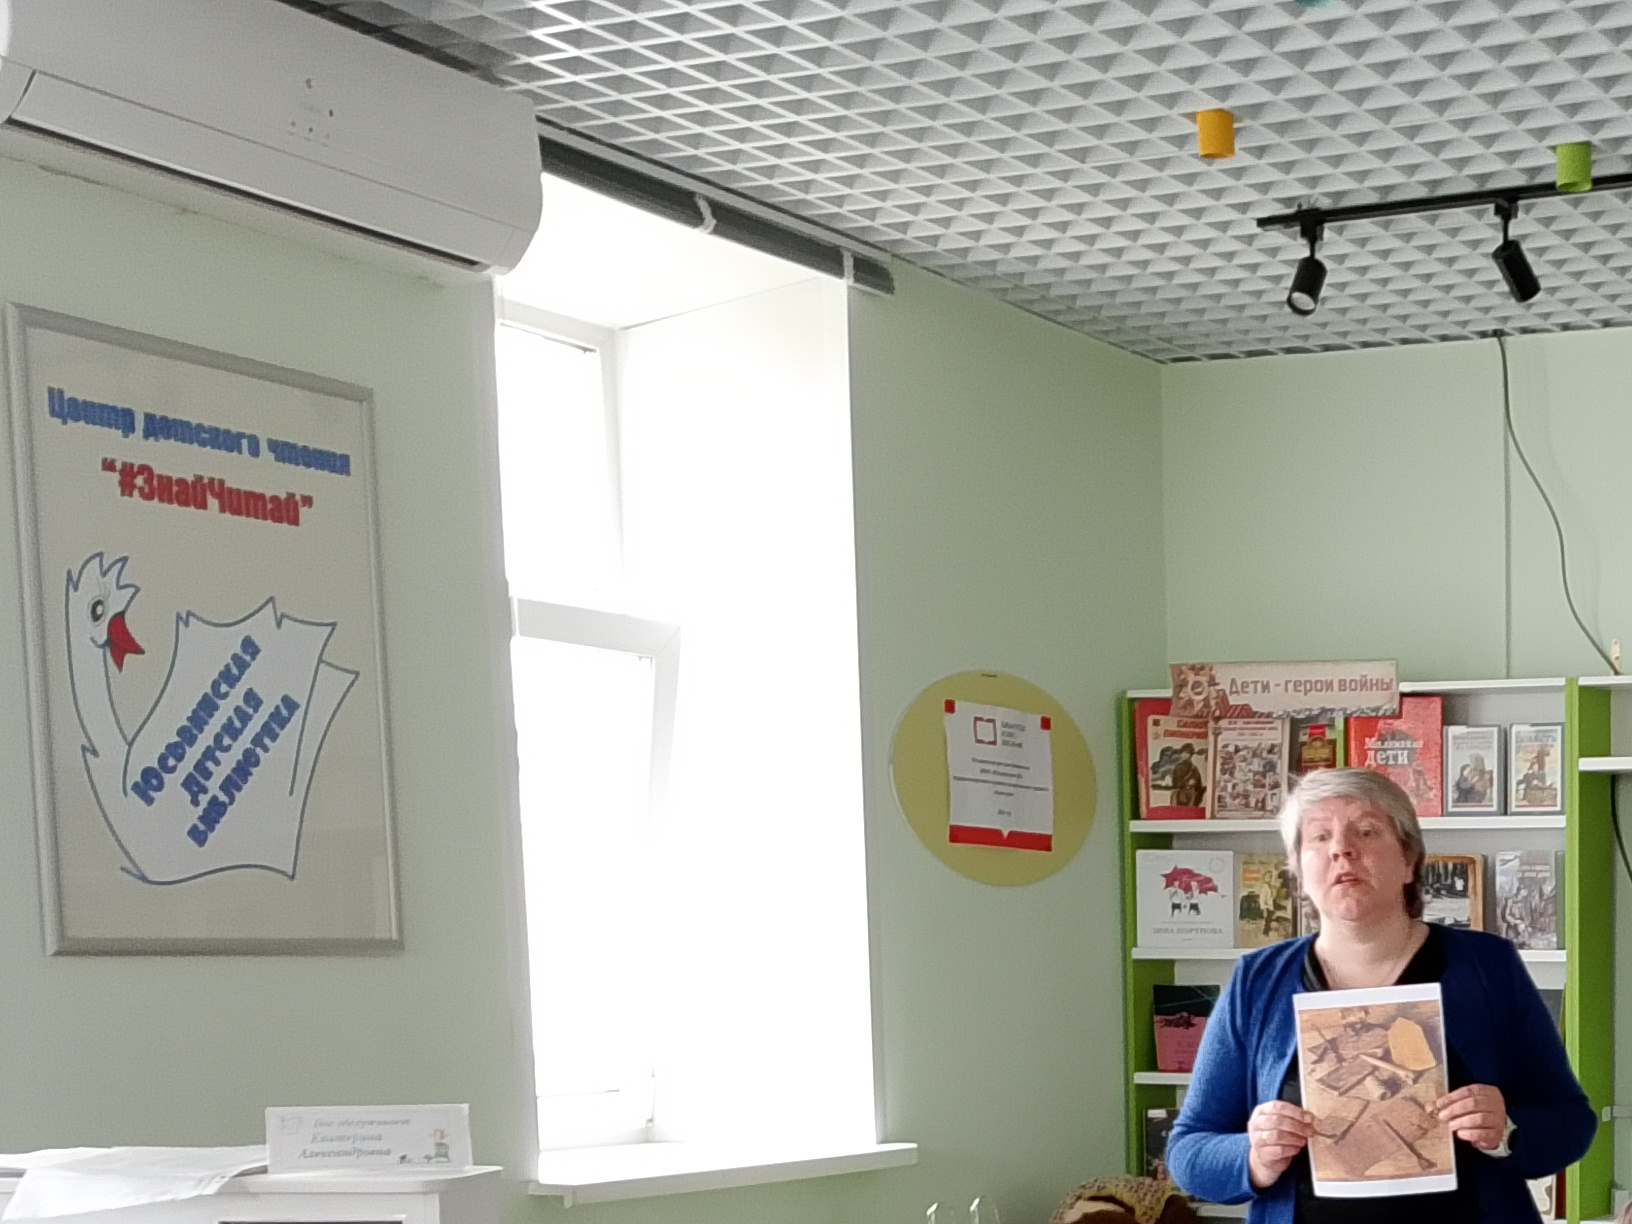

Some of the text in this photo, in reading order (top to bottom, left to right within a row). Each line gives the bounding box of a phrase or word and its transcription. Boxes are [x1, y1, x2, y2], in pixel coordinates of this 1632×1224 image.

[47, 386, 350, 477] Центр детского чтения
[131, 635, 262, 807] ЮСЬВИНСКАЯ
[1229, 677, 1271, 696] Дети
[1284, 678, 1335, 696] герои
[1338, 674, 1394, 692] войны
[180, 687, 264, 807] ДЕТСКАЯ
[187, 694, 300, 847] БИБЛИОТЕКА
